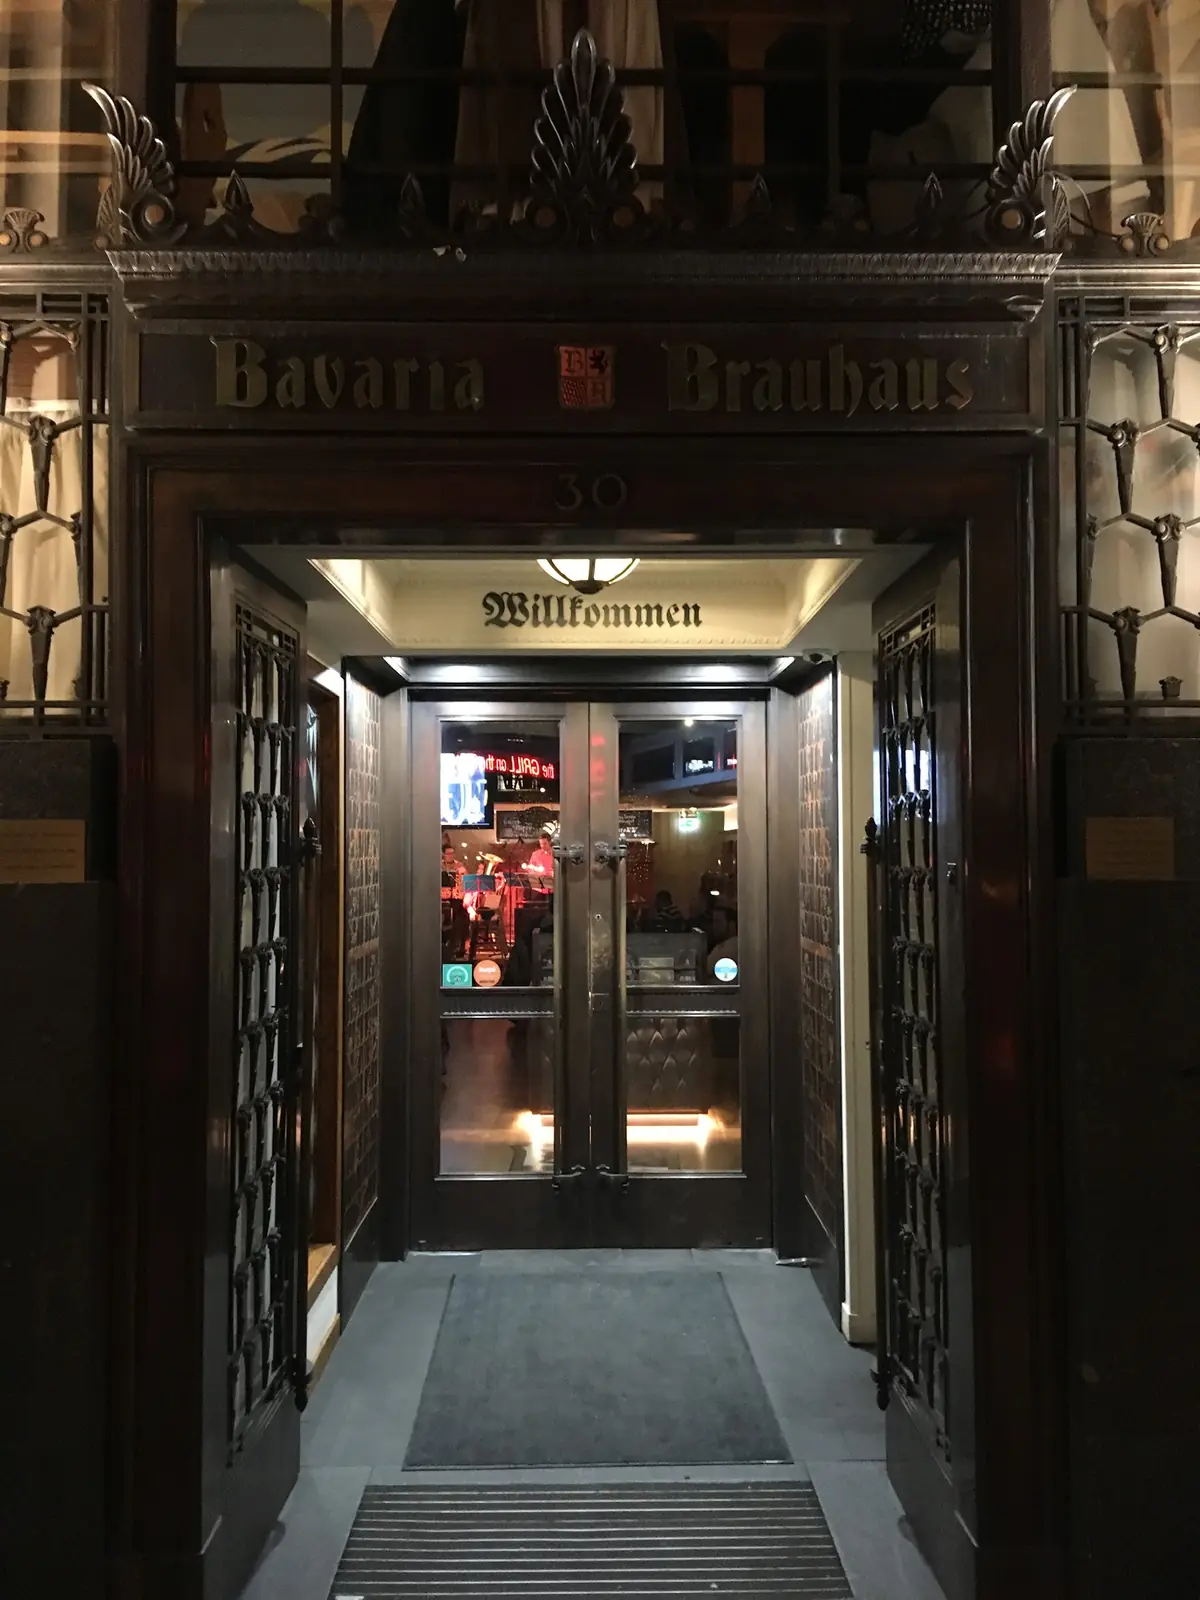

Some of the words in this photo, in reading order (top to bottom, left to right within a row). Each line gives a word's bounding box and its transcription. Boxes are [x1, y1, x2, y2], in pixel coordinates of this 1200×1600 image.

[209, 336, 484, 411] Bavaria
[660, 340, 974, 418] Brauhaus
[555, 473, 628, 509] 30
[482, 592, 702, 628] Willkommen
